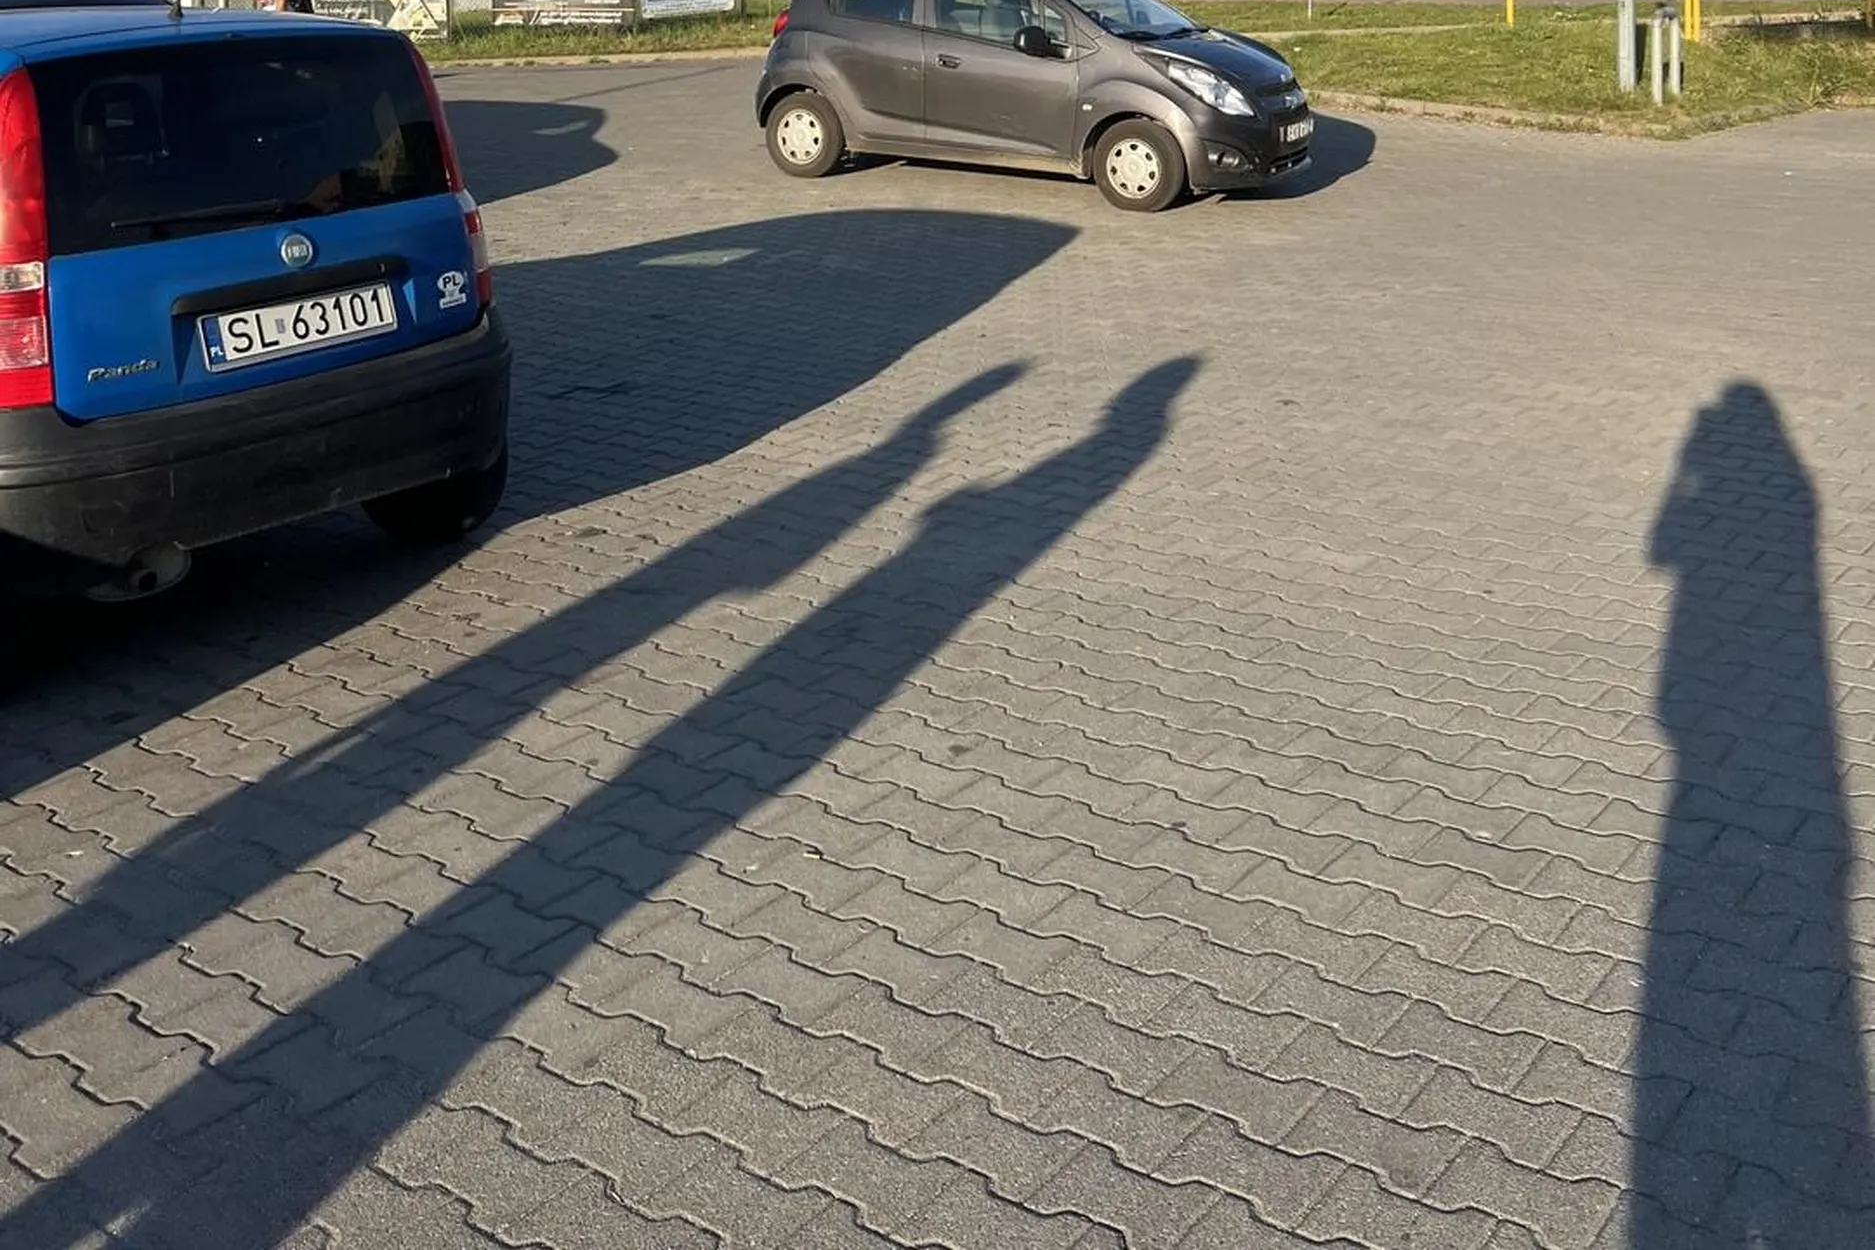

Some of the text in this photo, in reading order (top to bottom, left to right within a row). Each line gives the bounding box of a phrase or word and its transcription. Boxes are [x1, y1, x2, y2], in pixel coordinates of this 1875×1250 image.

[442, 274, 460, 289] PL
[227, 288, 386, 354] SL 63101
